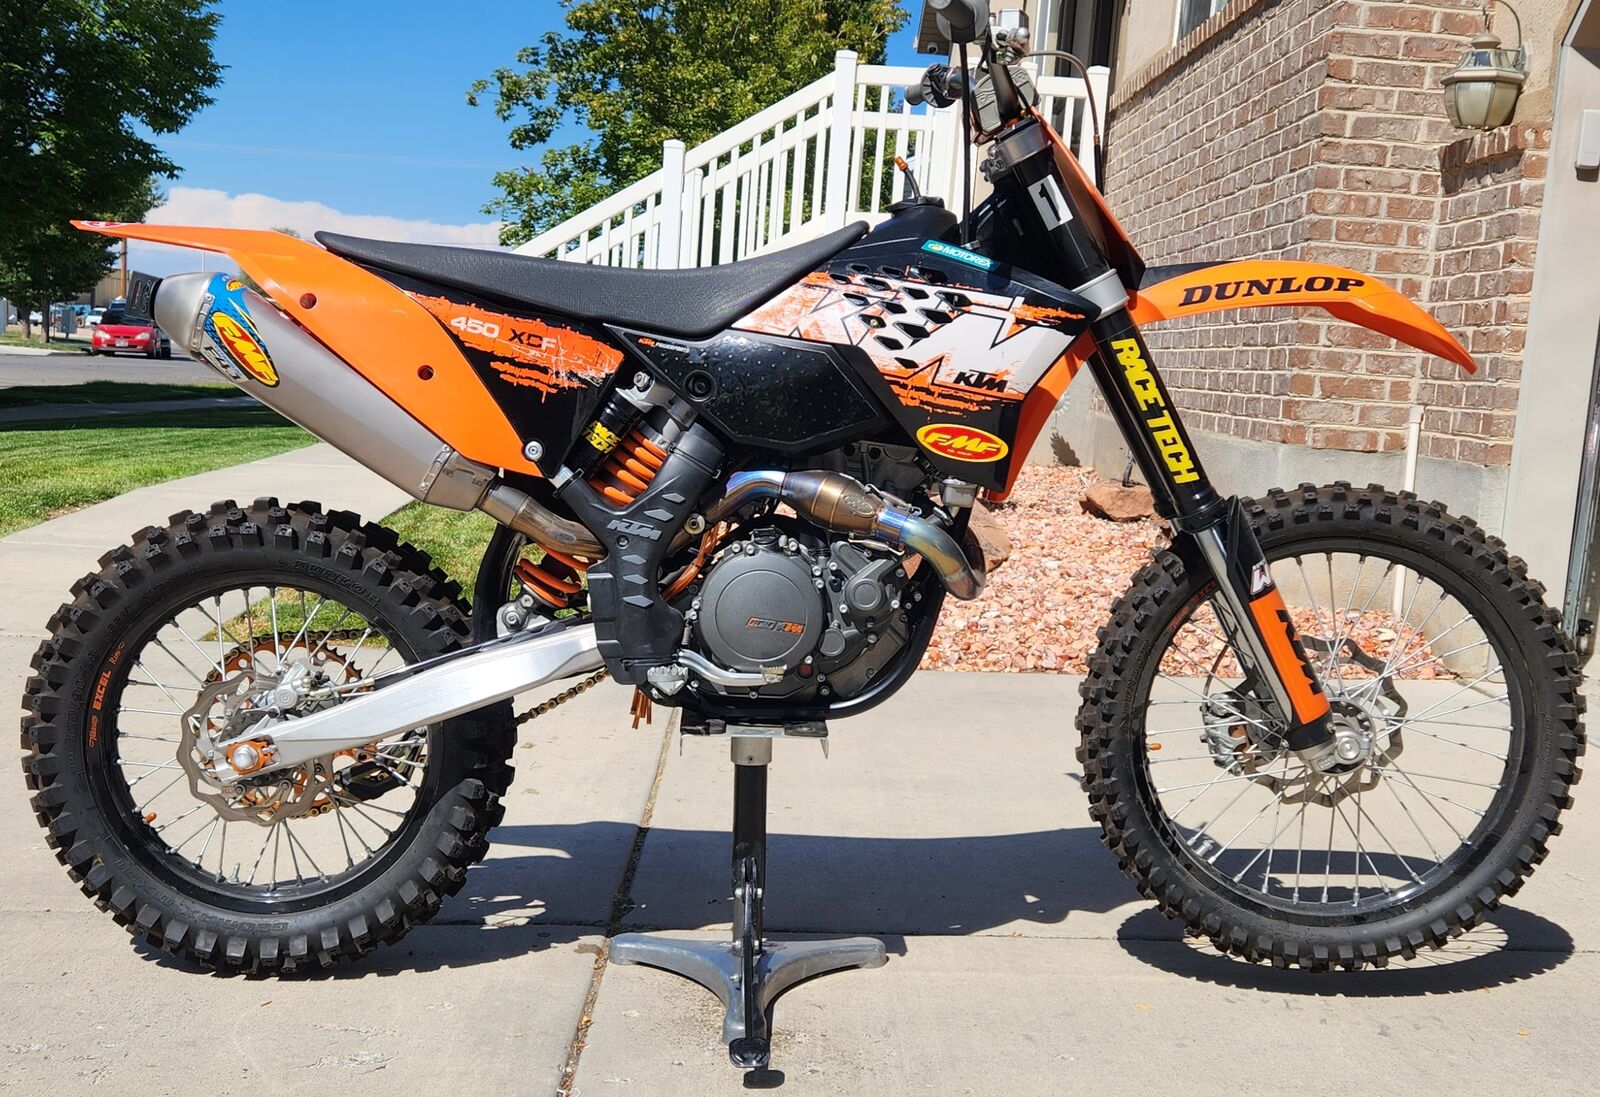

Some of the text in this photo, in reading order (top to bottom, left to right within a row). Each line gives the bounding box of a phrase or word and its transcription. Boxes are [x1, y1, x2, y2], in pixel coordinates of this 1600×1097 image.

[1038, 182, 1061, 223] 1
[942, 246, 994, 269] MOTOREX
[1178, 276, 1365, 307] DUNLOP
[450, 315, 557, 351] 450 XCF
[953, 369, 1008, 393] KTM
[1110, 338, 1200, 484] RACE TECH
[924, 432, 1001, 453] FMF
[607, 518, 662, 541] KTM
[92, 669, 112, 711] EXCEL
